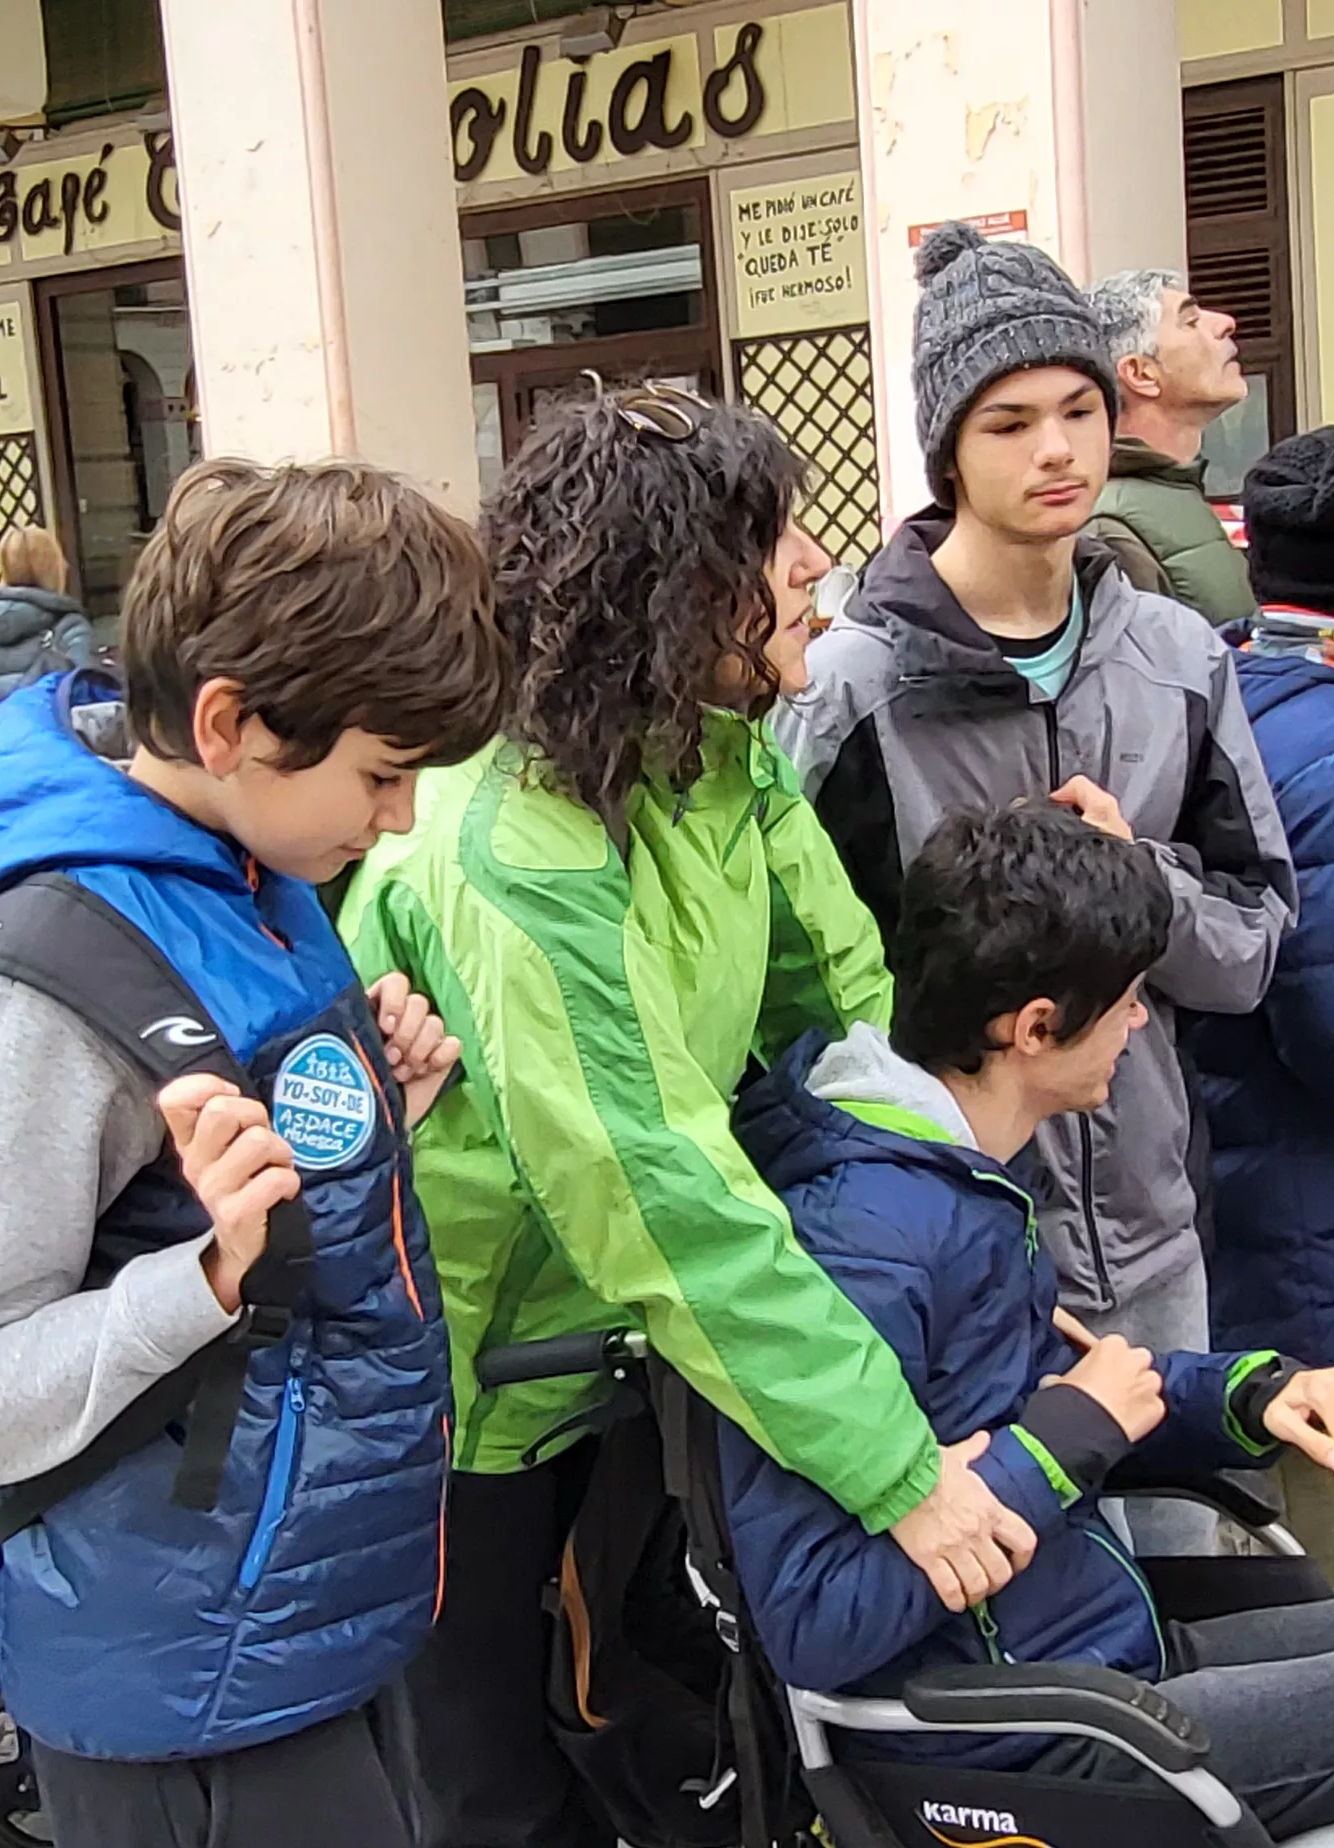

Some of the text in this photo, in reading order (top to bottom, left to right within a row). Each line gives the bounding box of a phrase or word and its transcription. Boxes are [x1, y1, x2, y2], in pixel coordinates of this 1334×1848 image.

[738, 202, 762, 222] ME
[801, 194, 818, 210] UN
[819, 177, 855, 208] CAFÉ
[740, 231, 751, 250] Y
[758, 228, 773, 246] LE
[923, 1800, 1019, 1834] karma
